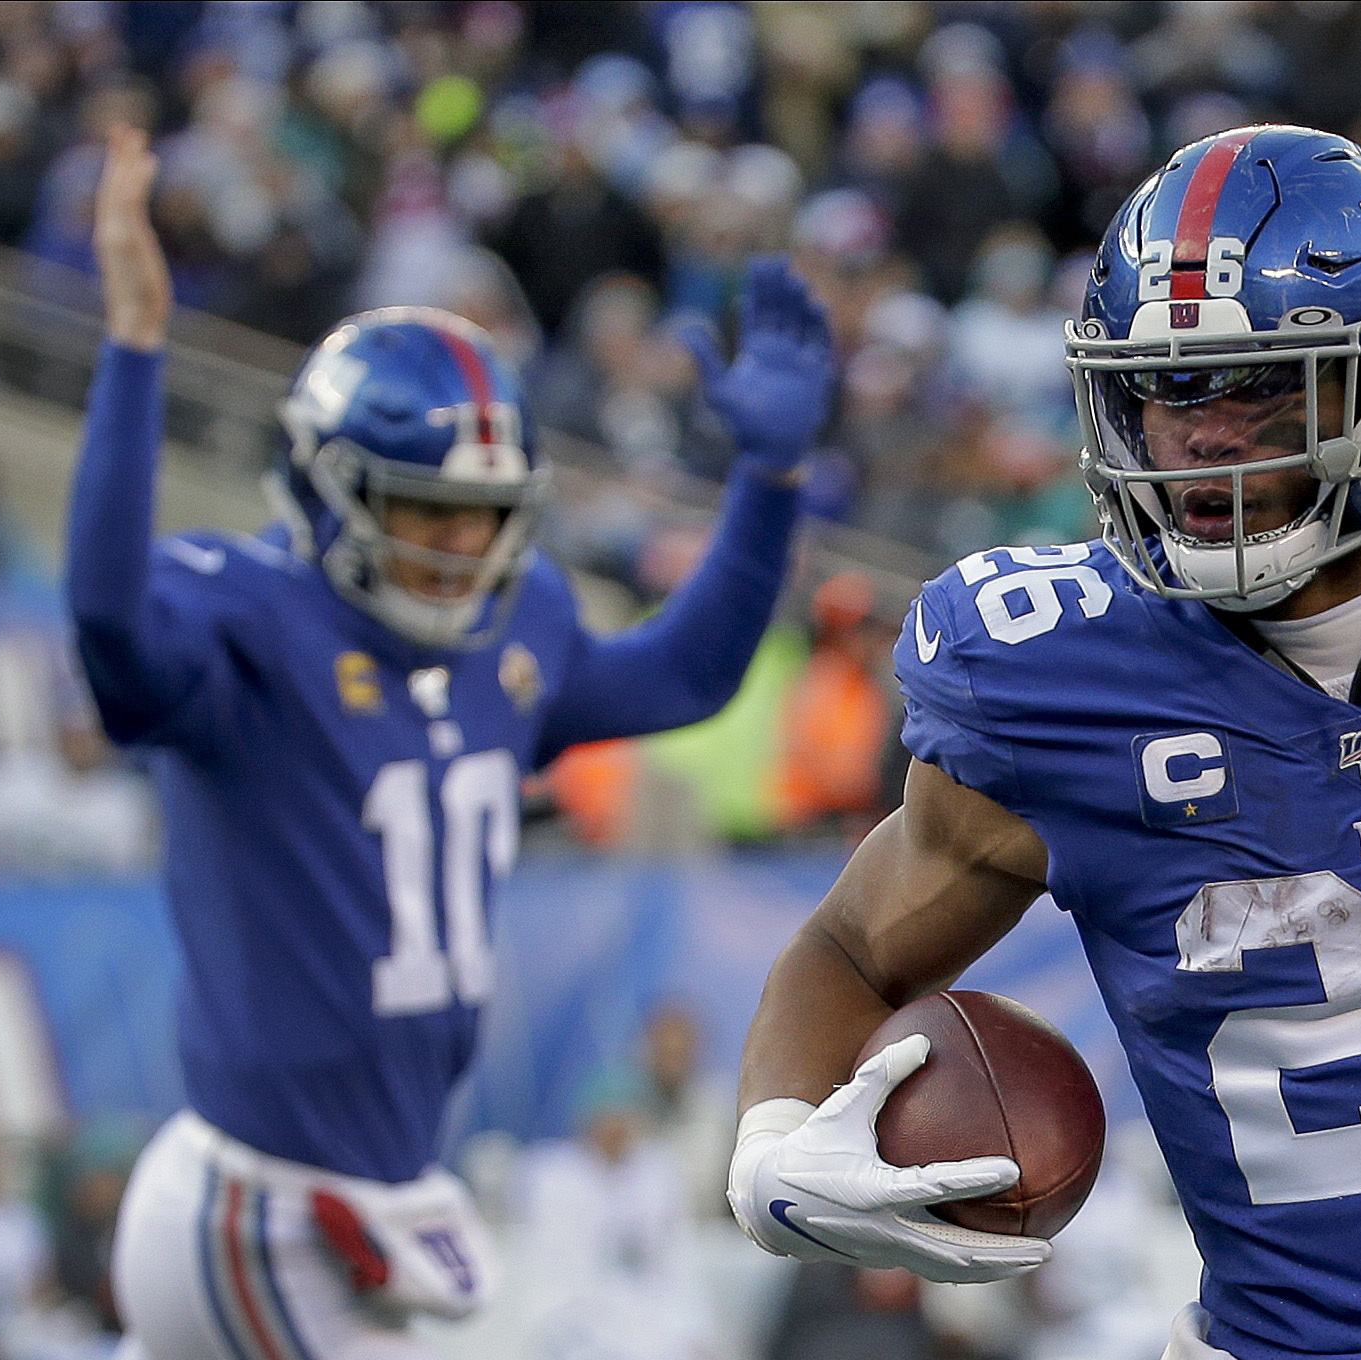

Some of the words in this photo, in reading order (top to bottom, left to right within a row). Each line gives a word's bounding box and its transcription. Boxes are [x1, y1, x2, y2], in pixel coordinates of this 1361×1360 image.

[1138, 236, 1246, 302] 26
[955, 542, 1114, 646] 26
[1140, 730, 1227, 804] C
[361, 746, 521, 1018] 10
